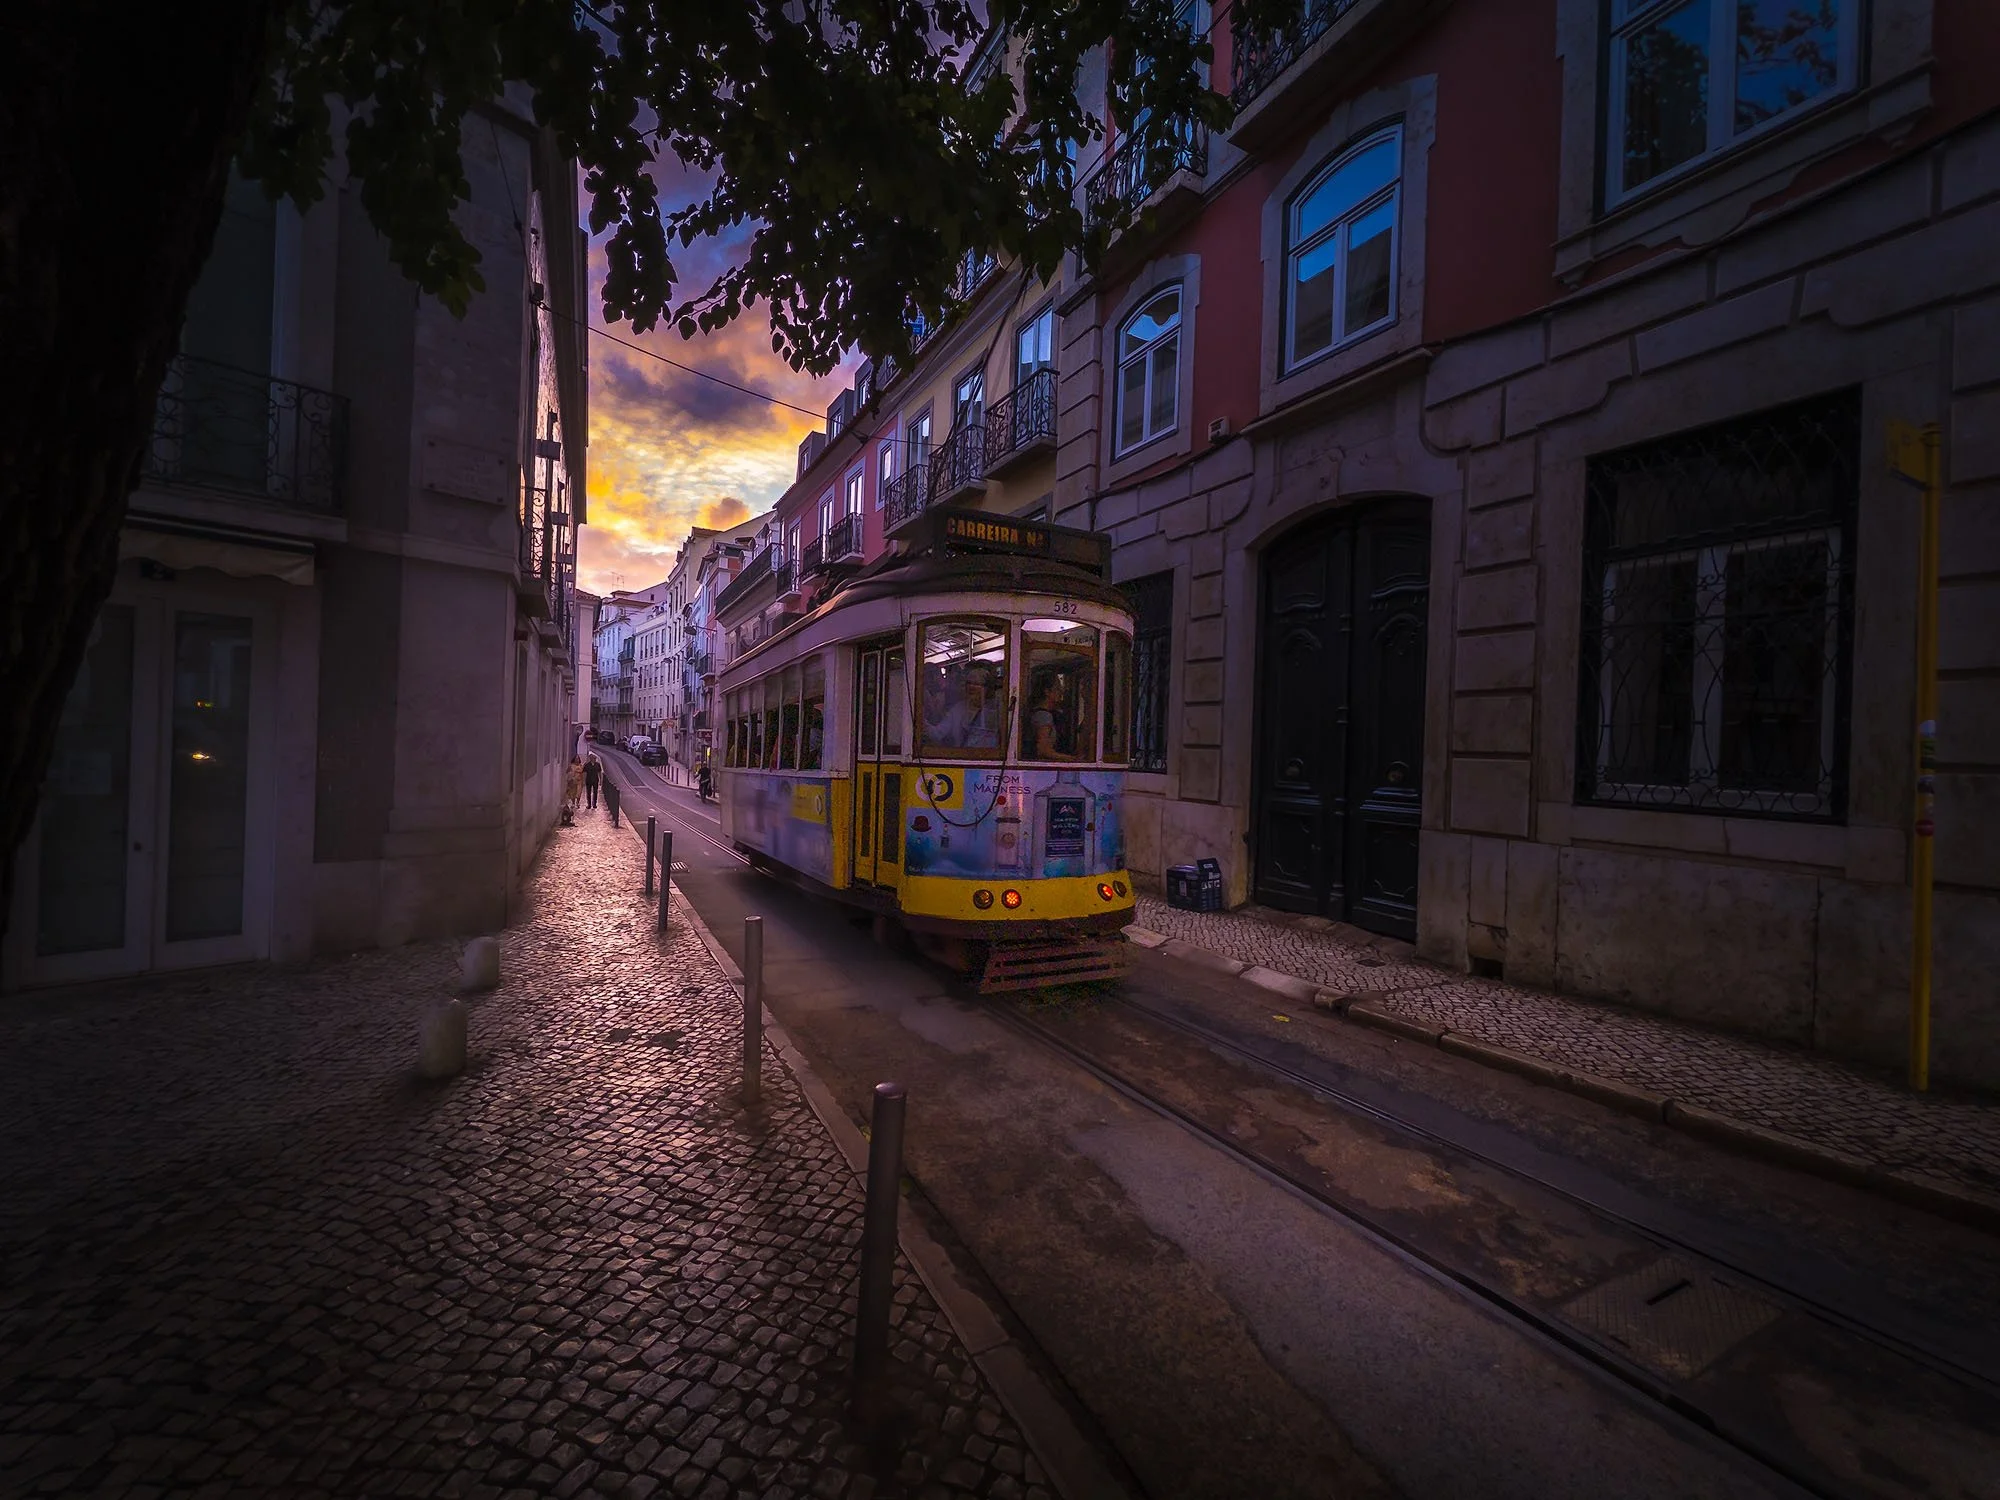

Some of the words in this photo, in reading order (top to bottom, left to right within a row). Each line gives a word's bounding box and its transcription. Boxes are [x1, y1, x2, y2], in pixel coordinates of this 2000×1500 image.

[1054, 601, 1077, 615] 582
[986, 775, 1020, 783] FROM
[974, 783, 1031, 794] MADNESS
